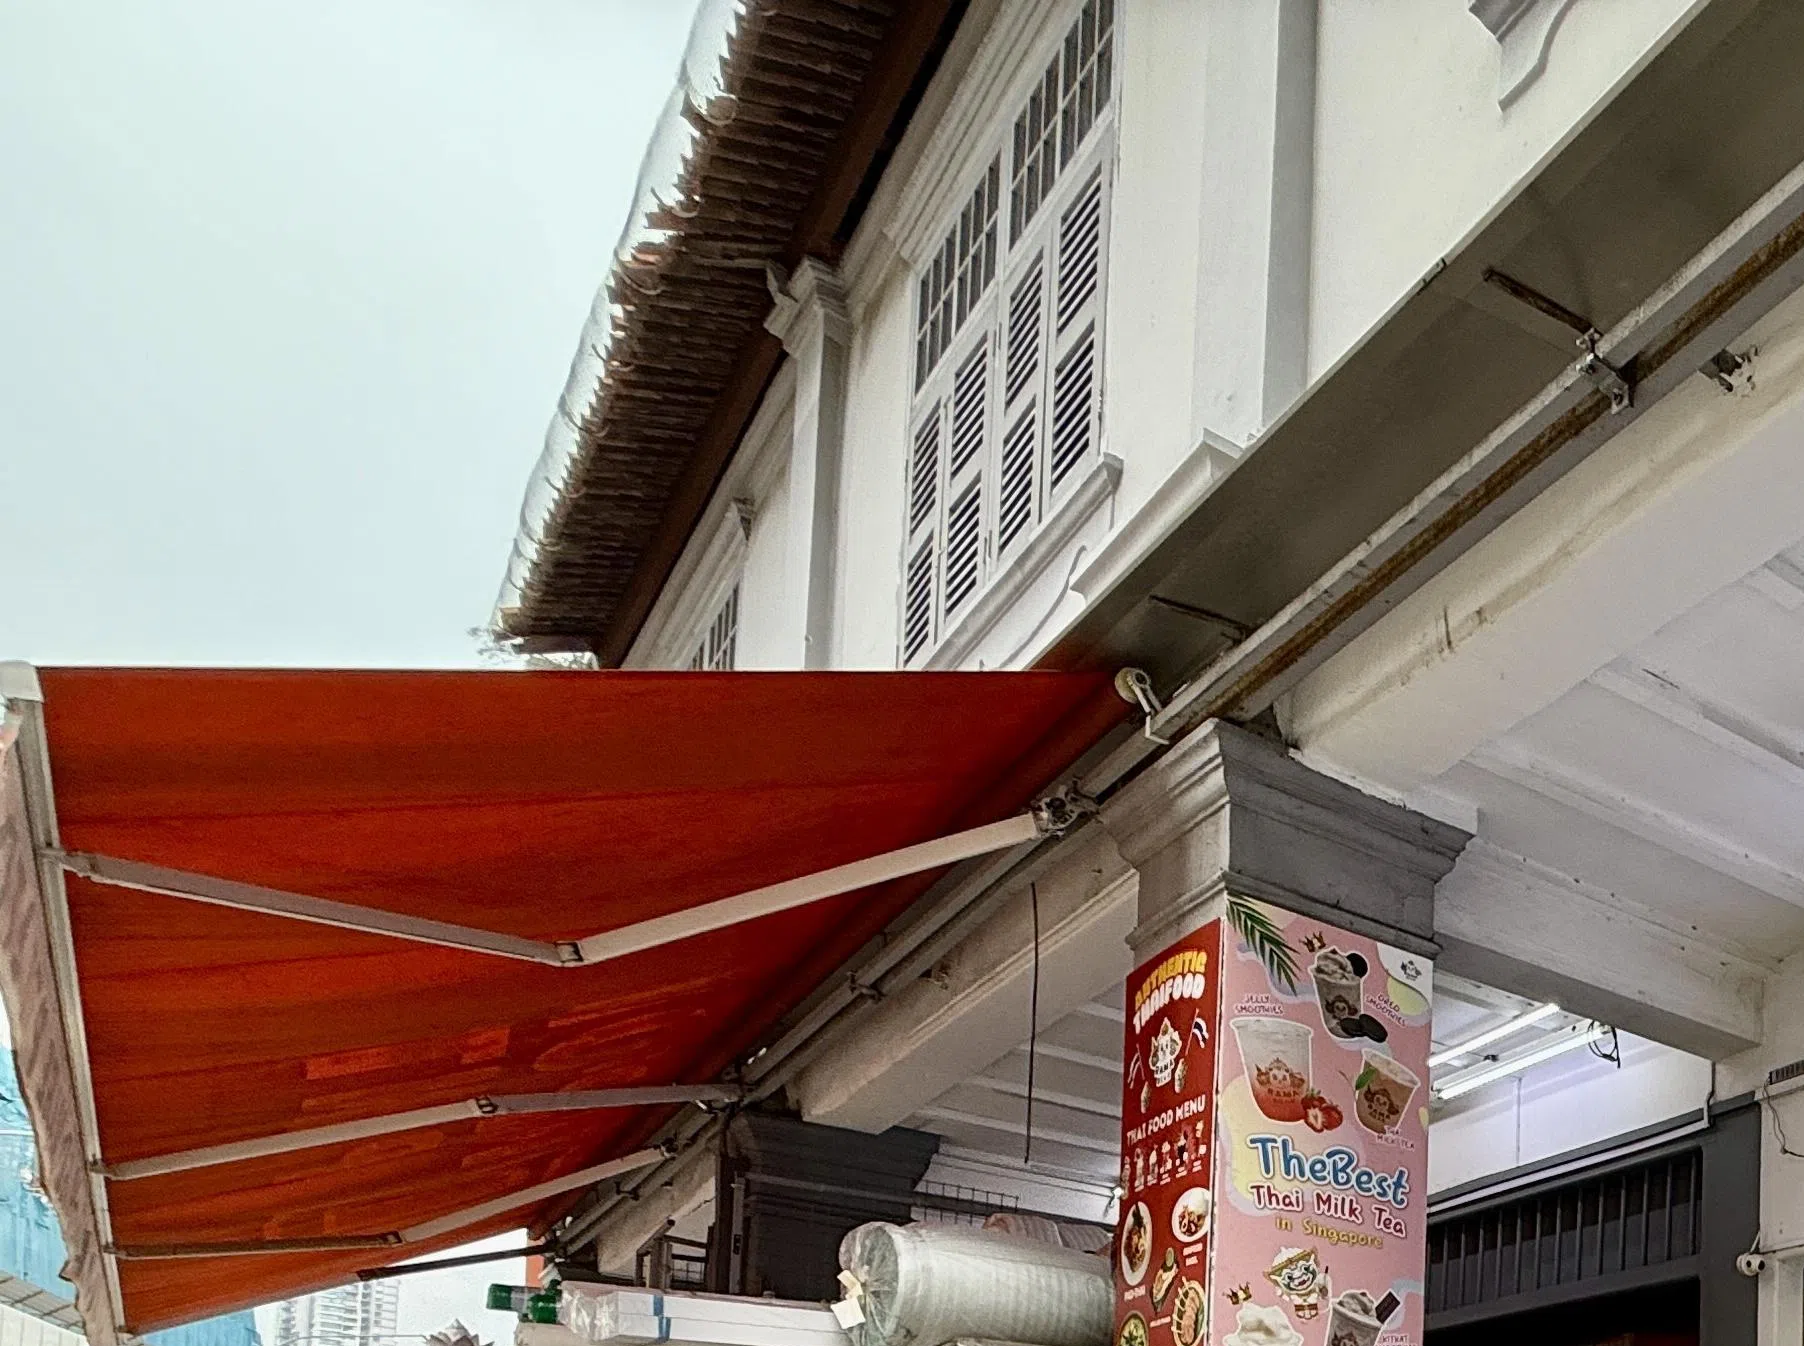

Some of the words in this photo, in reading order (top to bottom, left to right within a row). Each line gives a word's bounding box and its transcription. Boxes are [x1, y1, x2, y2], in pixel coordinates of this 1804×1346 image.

[1135, 950, 1207, 1010] AUTHENTIC
[1235, 1004, 1284, 1015] SMOOTHIES
[1245, 994, 1271, 1004] JELLY
[1366, 995, 1406, 1026] SMOOTHIES
[1127, 1124, 1146, 1147] THAI
[1147, 1110, 1174, 1136] FOOD
[1175, 1094, 1206, 1121] MENU
[1250, 1185, 1302, 1210] Thai
[1315, 1192, 1362, 1223] Milk
[1373, 1206, 1406, 1237] Tea
[1276, 1217, 1292, 1230] in
[1303, 1219, 1384, 1248] Singapore
